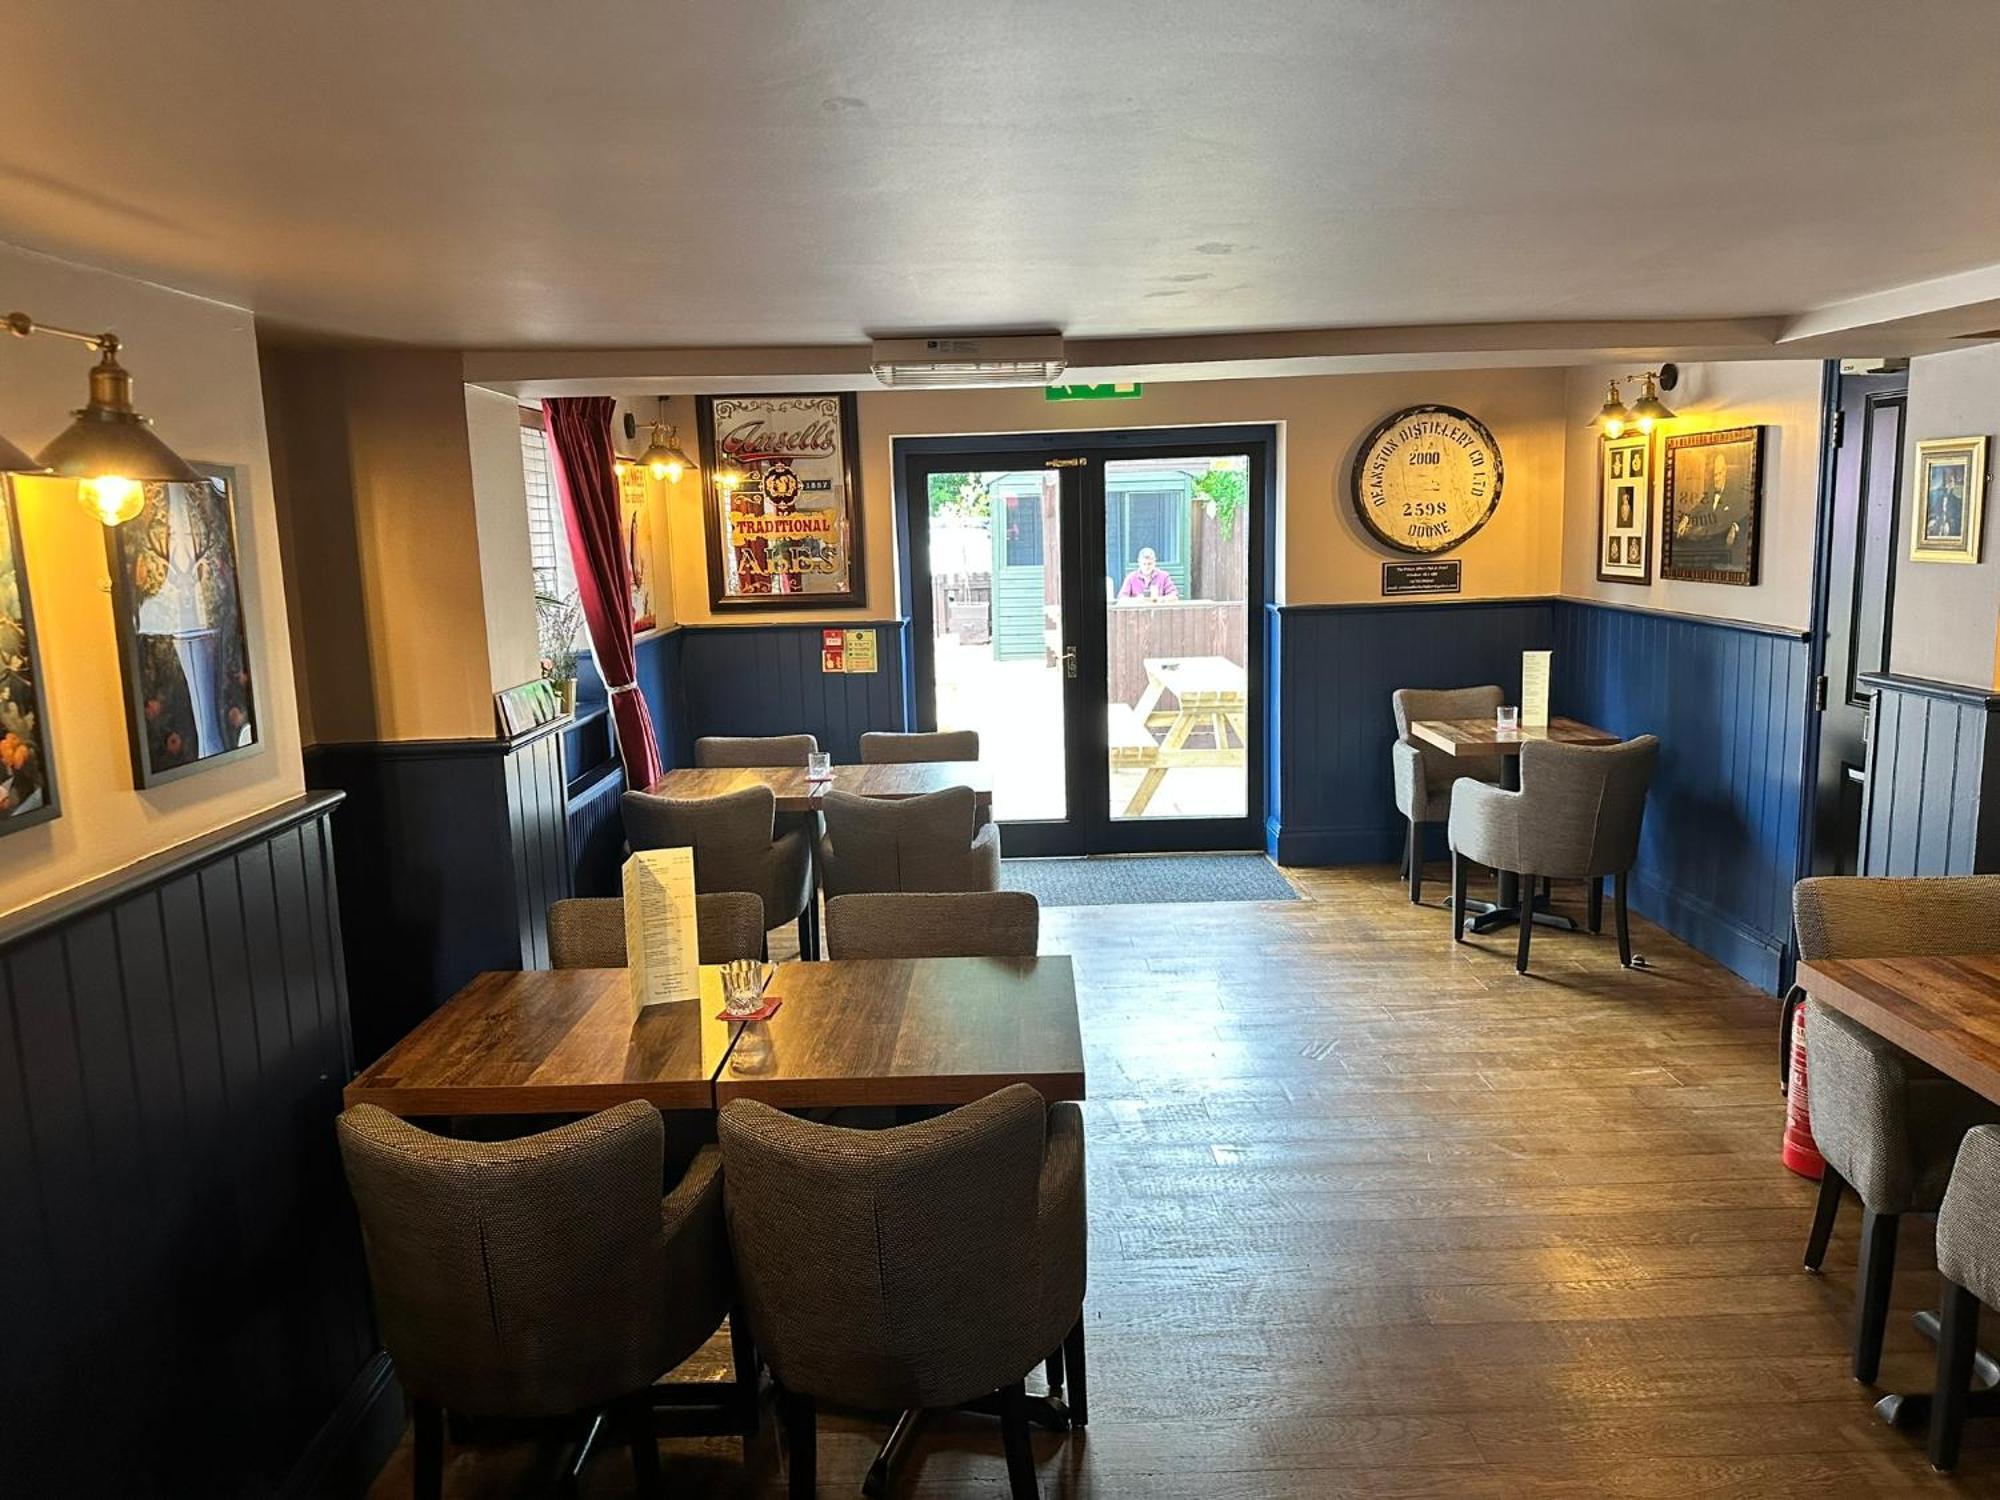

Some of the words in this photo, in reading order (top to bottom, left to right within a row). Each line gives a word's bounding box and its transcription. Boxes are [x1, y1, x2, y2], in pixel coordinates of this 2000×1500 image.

[722, 420, 836, 462] Ansells
[1370, 438, 1398, 507] DEANSTON
[1399, 421, 1474, 449] DISTILLERY
[1471, 472, 1486, 497] LTD
[1409, 451, 1440, 465] 2000
[1403, 502, 1447, 517] 2598
[736, 519, 830, 534] TRADITIONAL
[738, 545, 840, 577] ALES
